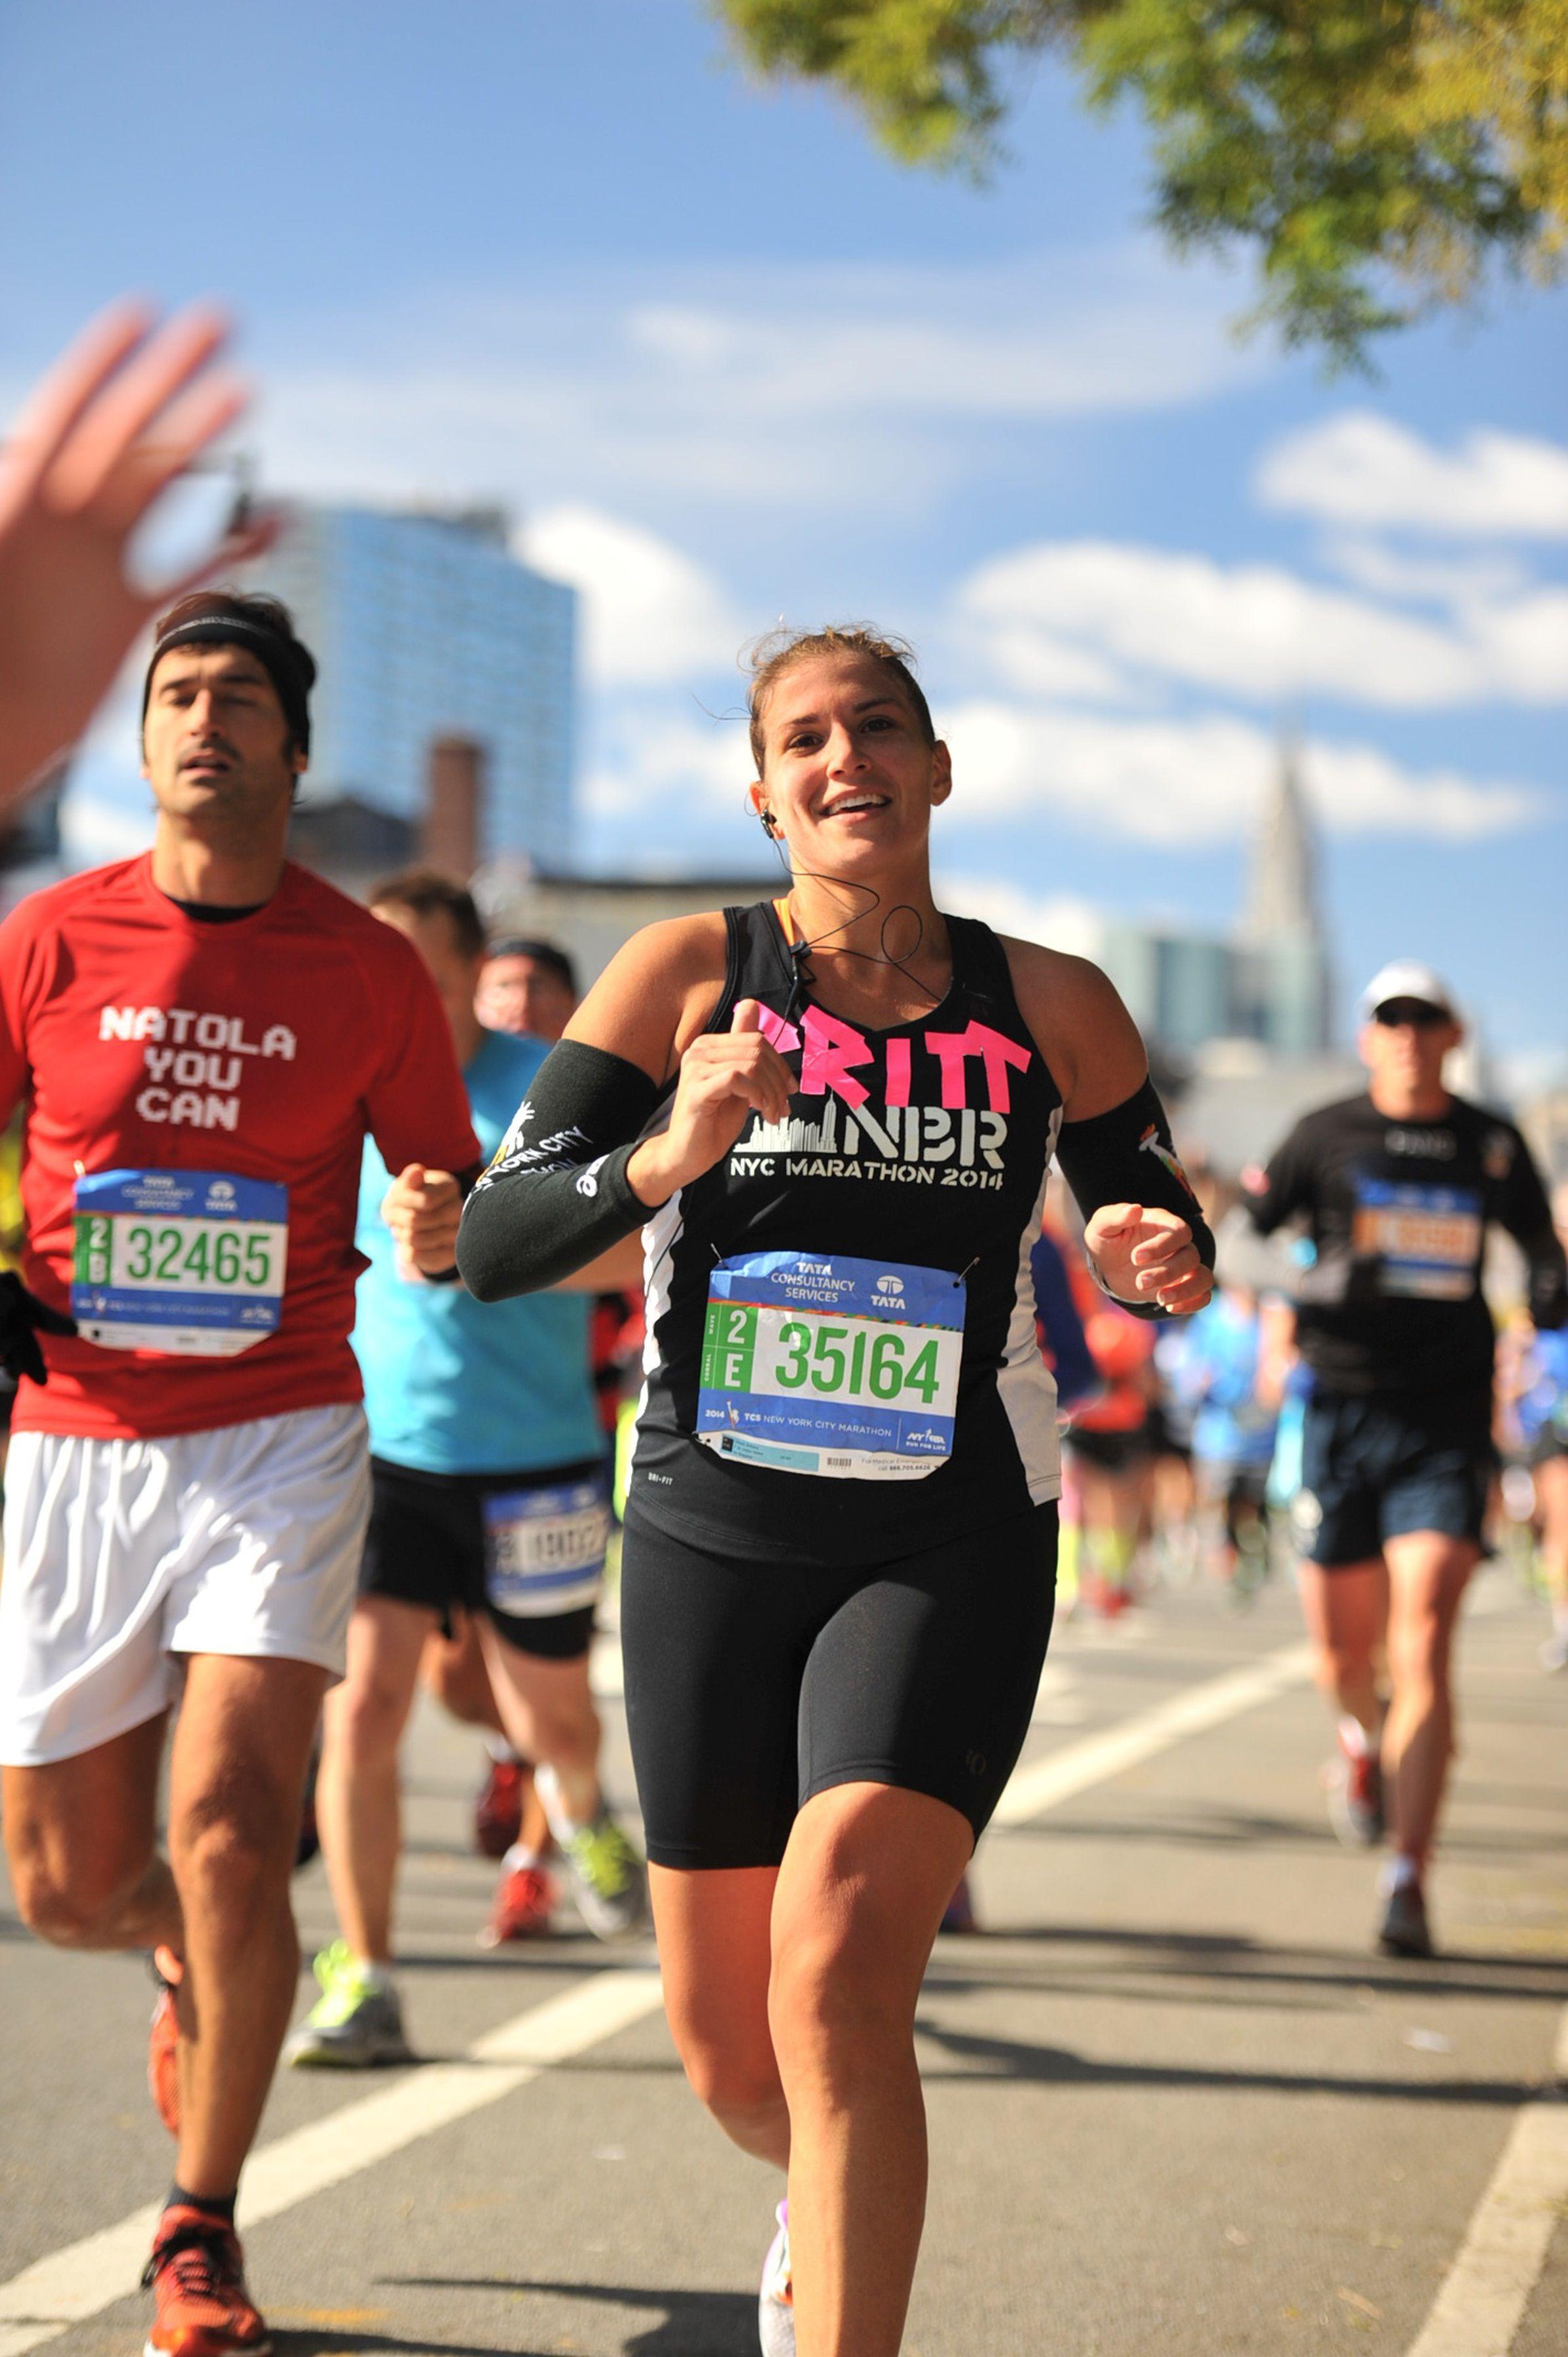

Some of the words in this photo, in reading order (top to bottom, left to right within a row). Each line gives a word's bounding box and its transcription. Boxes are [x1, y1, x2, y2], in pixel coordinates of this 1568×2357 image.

[100, 1006, 296, 1061] NATOLA
[145, 1047, 242, 1091] YOU
[136, 1087, 240, 1131] CAN
[538, 1125, 594, 1152] CITY
[843, 1101, 1008, 1169] NBR
[730, 1158, 775, 1177] NYC
[786, 1158, 935, 1185] MARATHON
[940, 1168, 1003, 1190] 2014
[90, 1218, 108, 1249] 2
[127, 1228, 271, 1286] 32465
[797, 1262, 832, 1275] TATA
[771, 1272, 855, 1292] CONSULTANCY
[786, 1287, 839, 1303] SERVICES
[871, 1294, 906, 1309] TATA
[727, 1309, 747, 1344] 2
[725, 1353, 743, 1387] E
[775, 1323, 939, 1404] 35164
[705, 1410, 725, 1419] 2014
[744, 1413, 761, 1422] TCS
[763, 1415, 785, 1424] NEW
[788, 1417, 812, 1428] YORK
[815, 1420, 837, 1431] CITY
[839, 1423, 892, 1436] MARATHON
